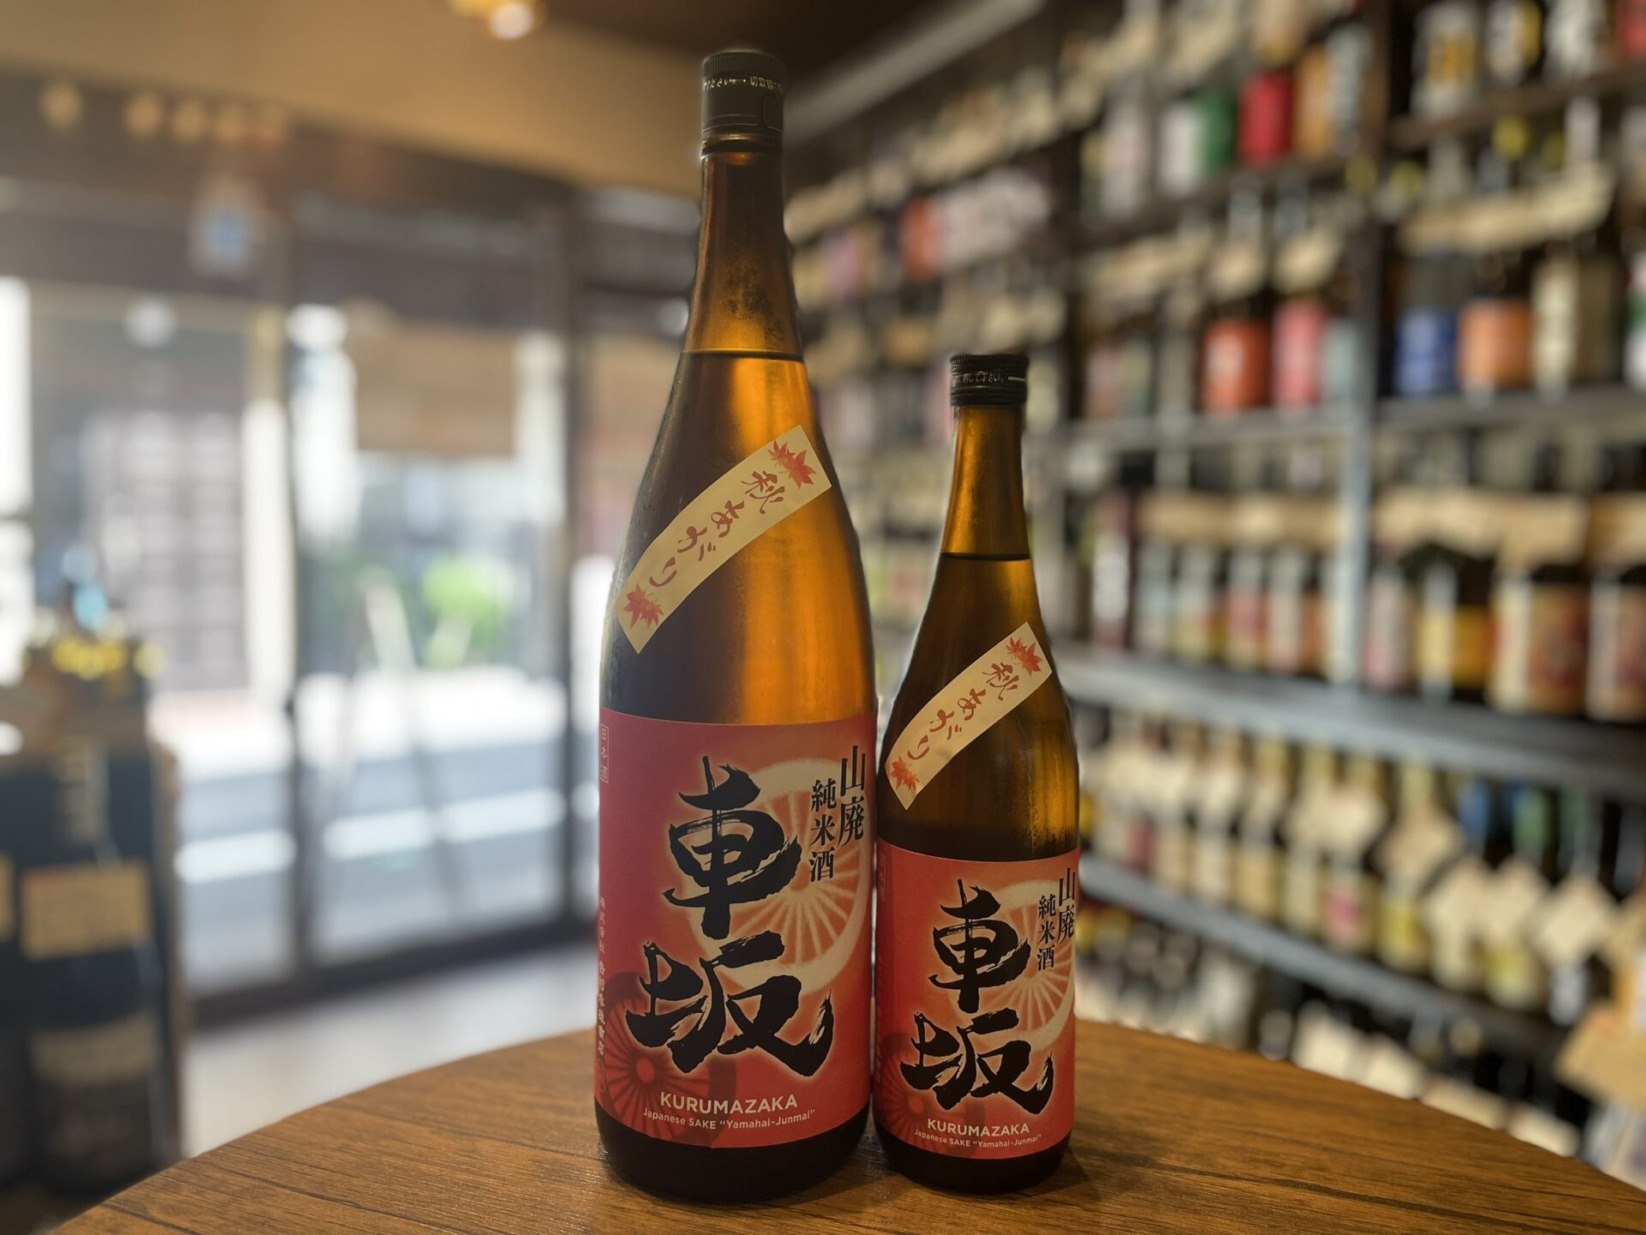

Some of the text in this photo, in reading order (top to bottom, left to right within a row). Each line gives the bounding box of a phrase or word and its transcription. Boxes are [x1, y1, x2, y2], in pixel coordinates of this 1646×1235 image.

[649, 470, 785, 587] 秋あがり
[907, 662, 1019, 760] 秋あがり
[809, 778, 837, 882] 純米酒
[838, 745, 866, 848] 山廃
[625, 755, 834, 1077] 車坂
[1037, 893, 1057, 971] 純米酒
[1057, 868, 1076, 944] 山廃
[900, 878, 1054, 1114] 車坂
[643, 1108, 686, 1126] Japanese
[689, 1117, 716, 1130] SAKE
[660, 1092, 797, 1115] KURUMAZAKA
[914, 1129, 948, 1144] Japanese
[949, 1138, 970, 1147] SAKE
[928, 1118, 1030, 1137] KURUMAZAKA
